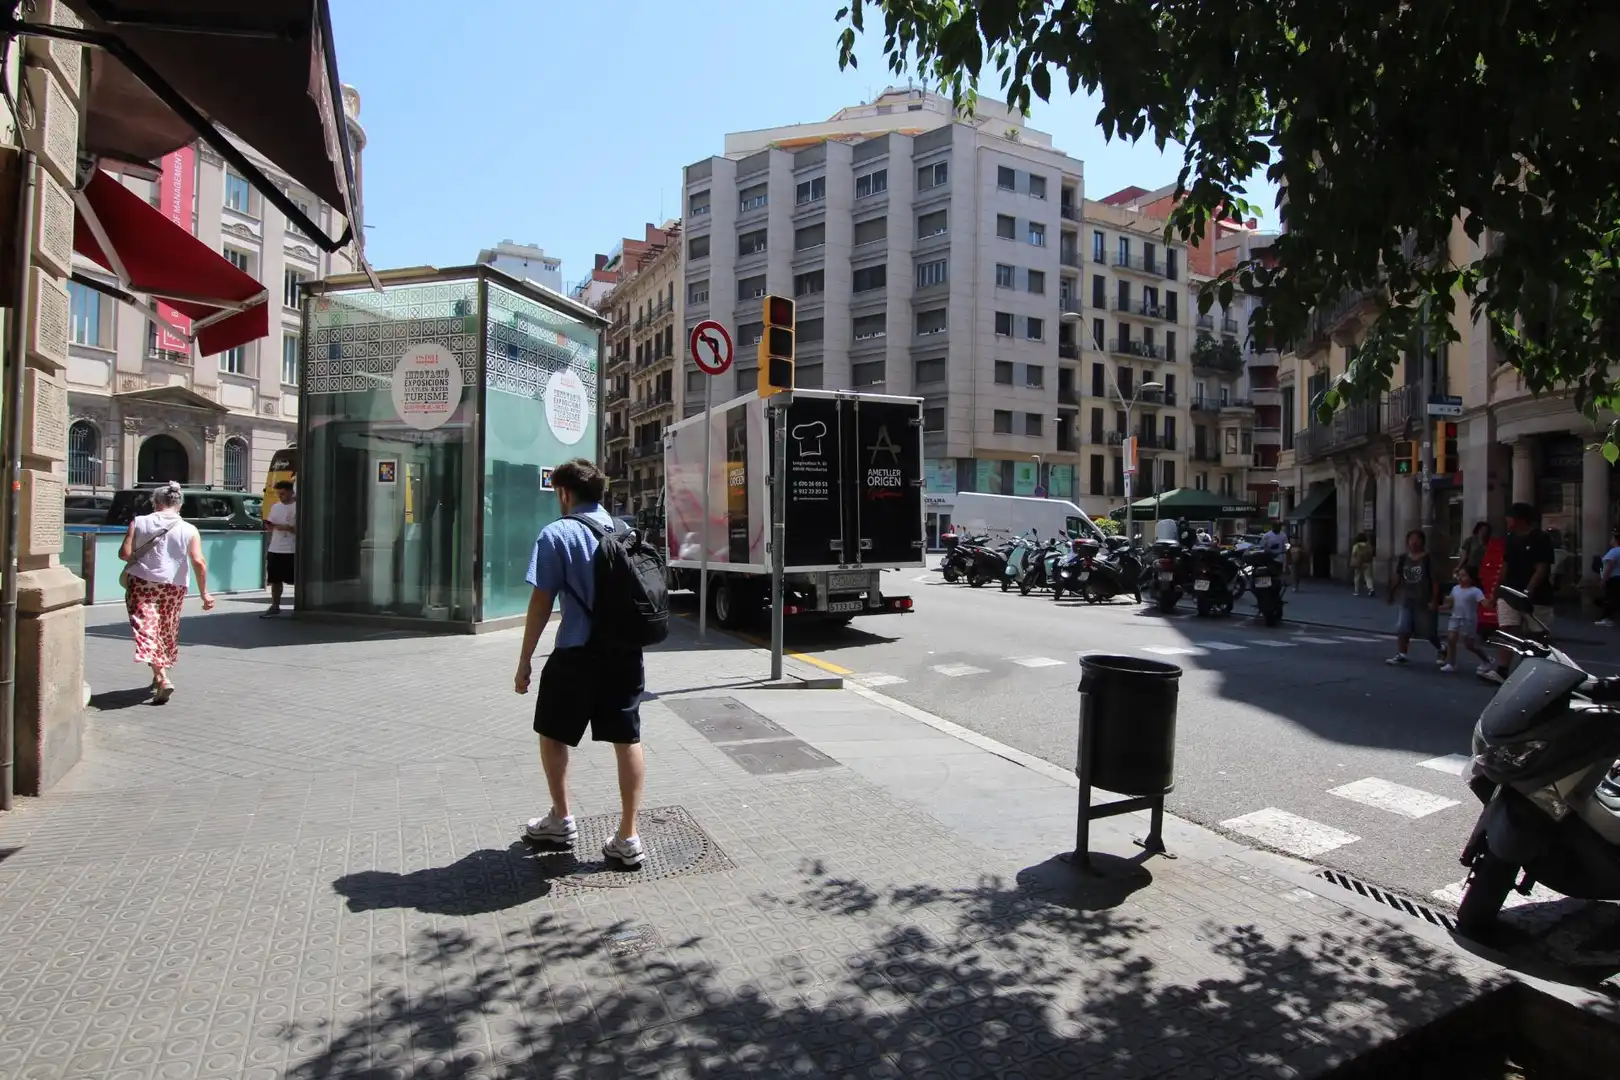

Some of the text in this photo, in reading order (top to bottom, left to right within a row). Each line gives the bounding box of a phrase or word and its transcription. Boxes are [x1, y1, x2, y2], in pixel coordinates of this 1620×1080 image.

[173, 152, 182, 213] MANAGEMENT
[404, 379, 449, 387] EXPOSICIONS
[404, 392, 449, 401] TURISME
[867, 468, 901, 477] AMETLLER
[866, 476, 902, 487] ORIGEN
